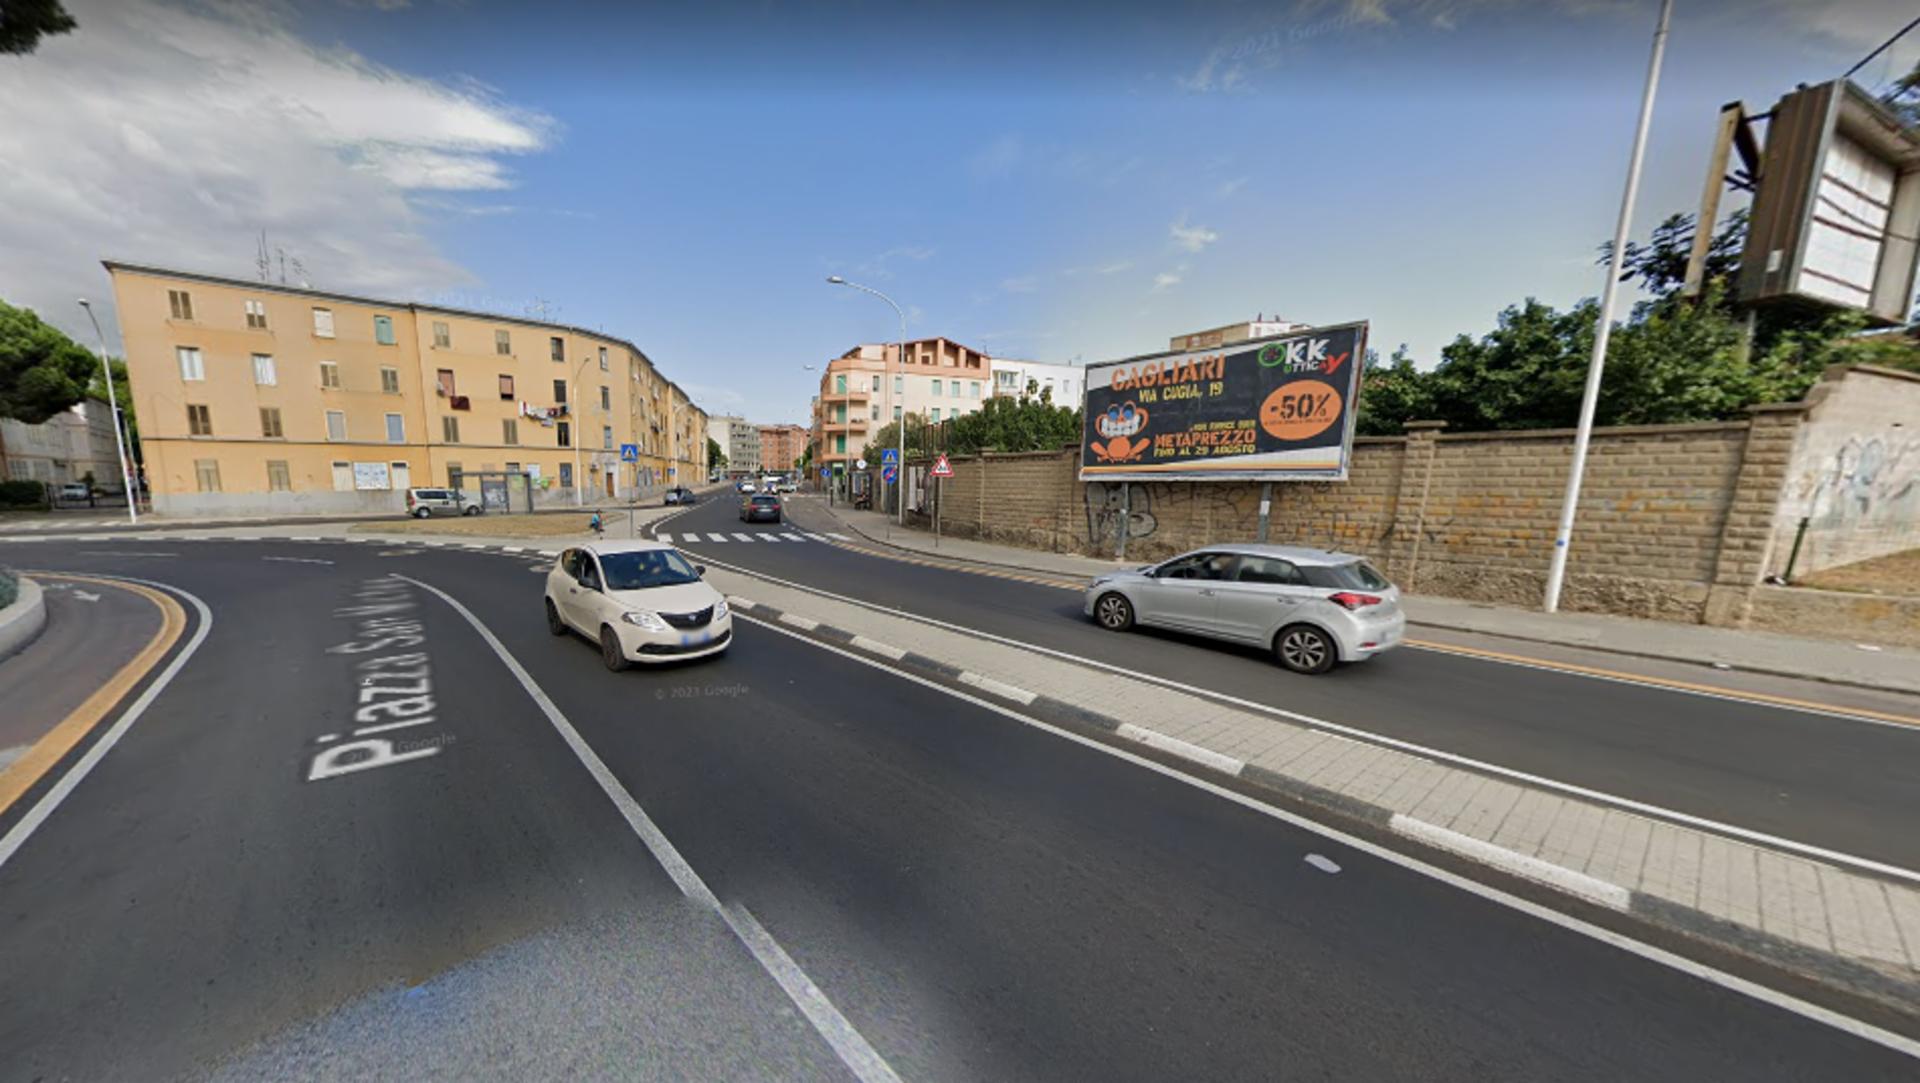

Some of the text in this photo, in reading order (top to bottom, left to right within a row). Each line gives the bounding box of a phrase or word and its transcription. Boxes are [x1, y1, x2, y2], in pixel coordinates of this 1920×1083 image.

[1111, 352, 1226, 391] CAGLIARI
[1139, 387, 1157, 402] VIA
[1210, 381, 1224, 397] 19
[1154, 429, 1256, 449] METAPREZZO
[1179, 446, 1191, 456] AL
[1212, 443, 1256, 456] AGOSTO
